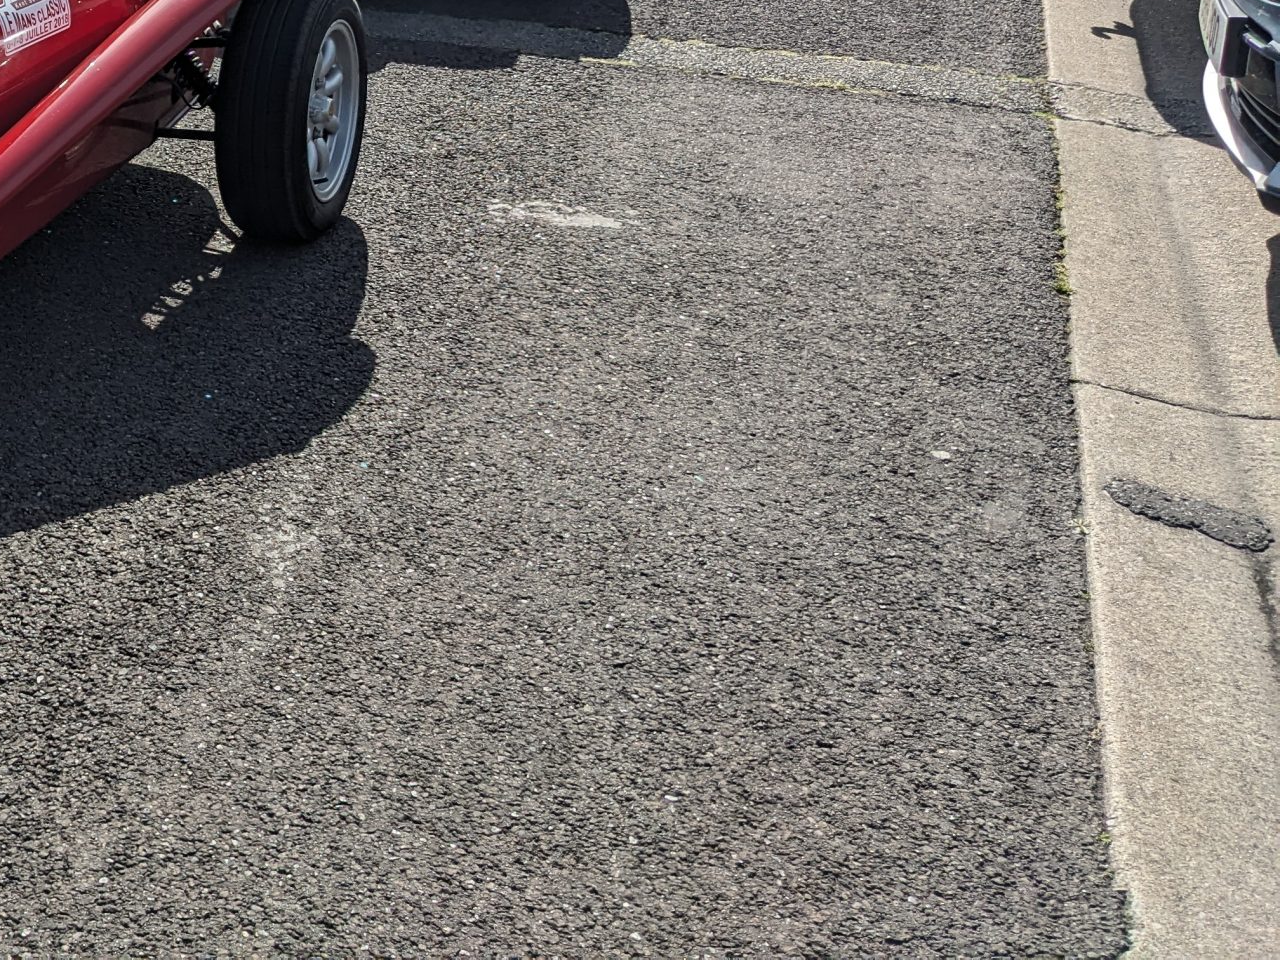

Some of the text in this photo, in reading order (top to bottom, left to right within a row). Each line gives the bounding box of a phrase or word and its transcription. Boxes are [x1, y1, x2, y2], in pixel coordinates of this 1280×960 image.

[0, 11, 16, 34] LE
[13, 13, 37, 30] MANS
[24, 21, 53, 42] JUILLET
